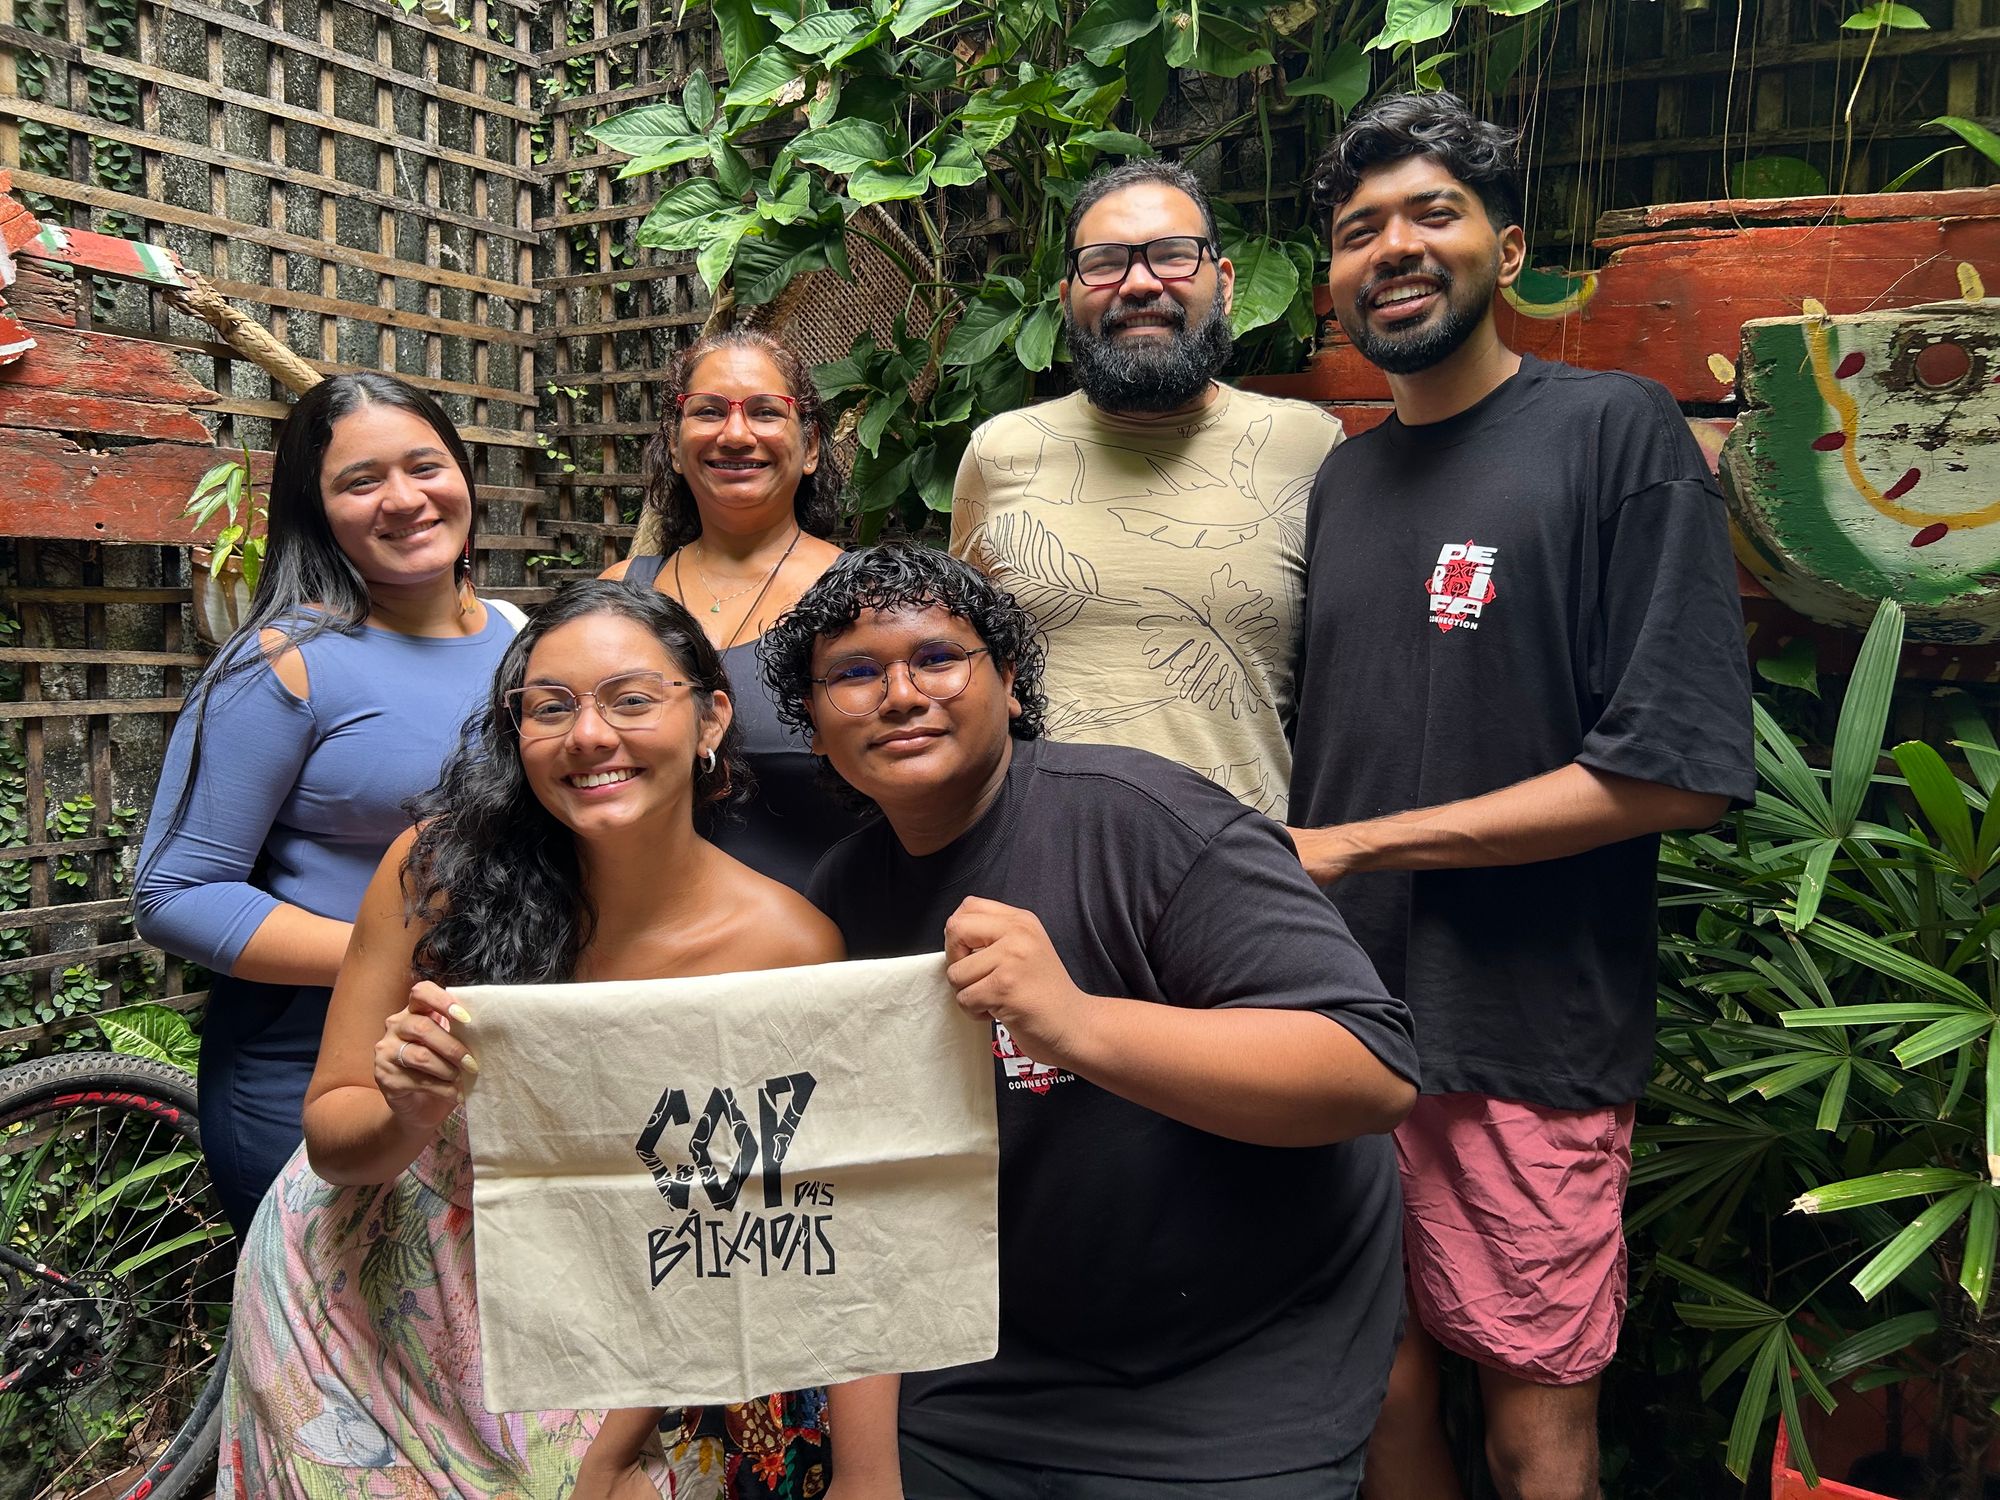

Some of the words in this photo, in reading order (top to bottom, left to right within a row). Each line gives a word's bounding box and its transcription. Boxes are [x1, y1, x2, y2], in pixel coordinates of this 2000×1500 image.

[1008, 1073, 1075, 1090] CONNECTION
[636, 1071, 817, 1212] COP
[794, 1180, 835, 1208] DAS
[648, 1208, 835, 1290] BAIXADAS
